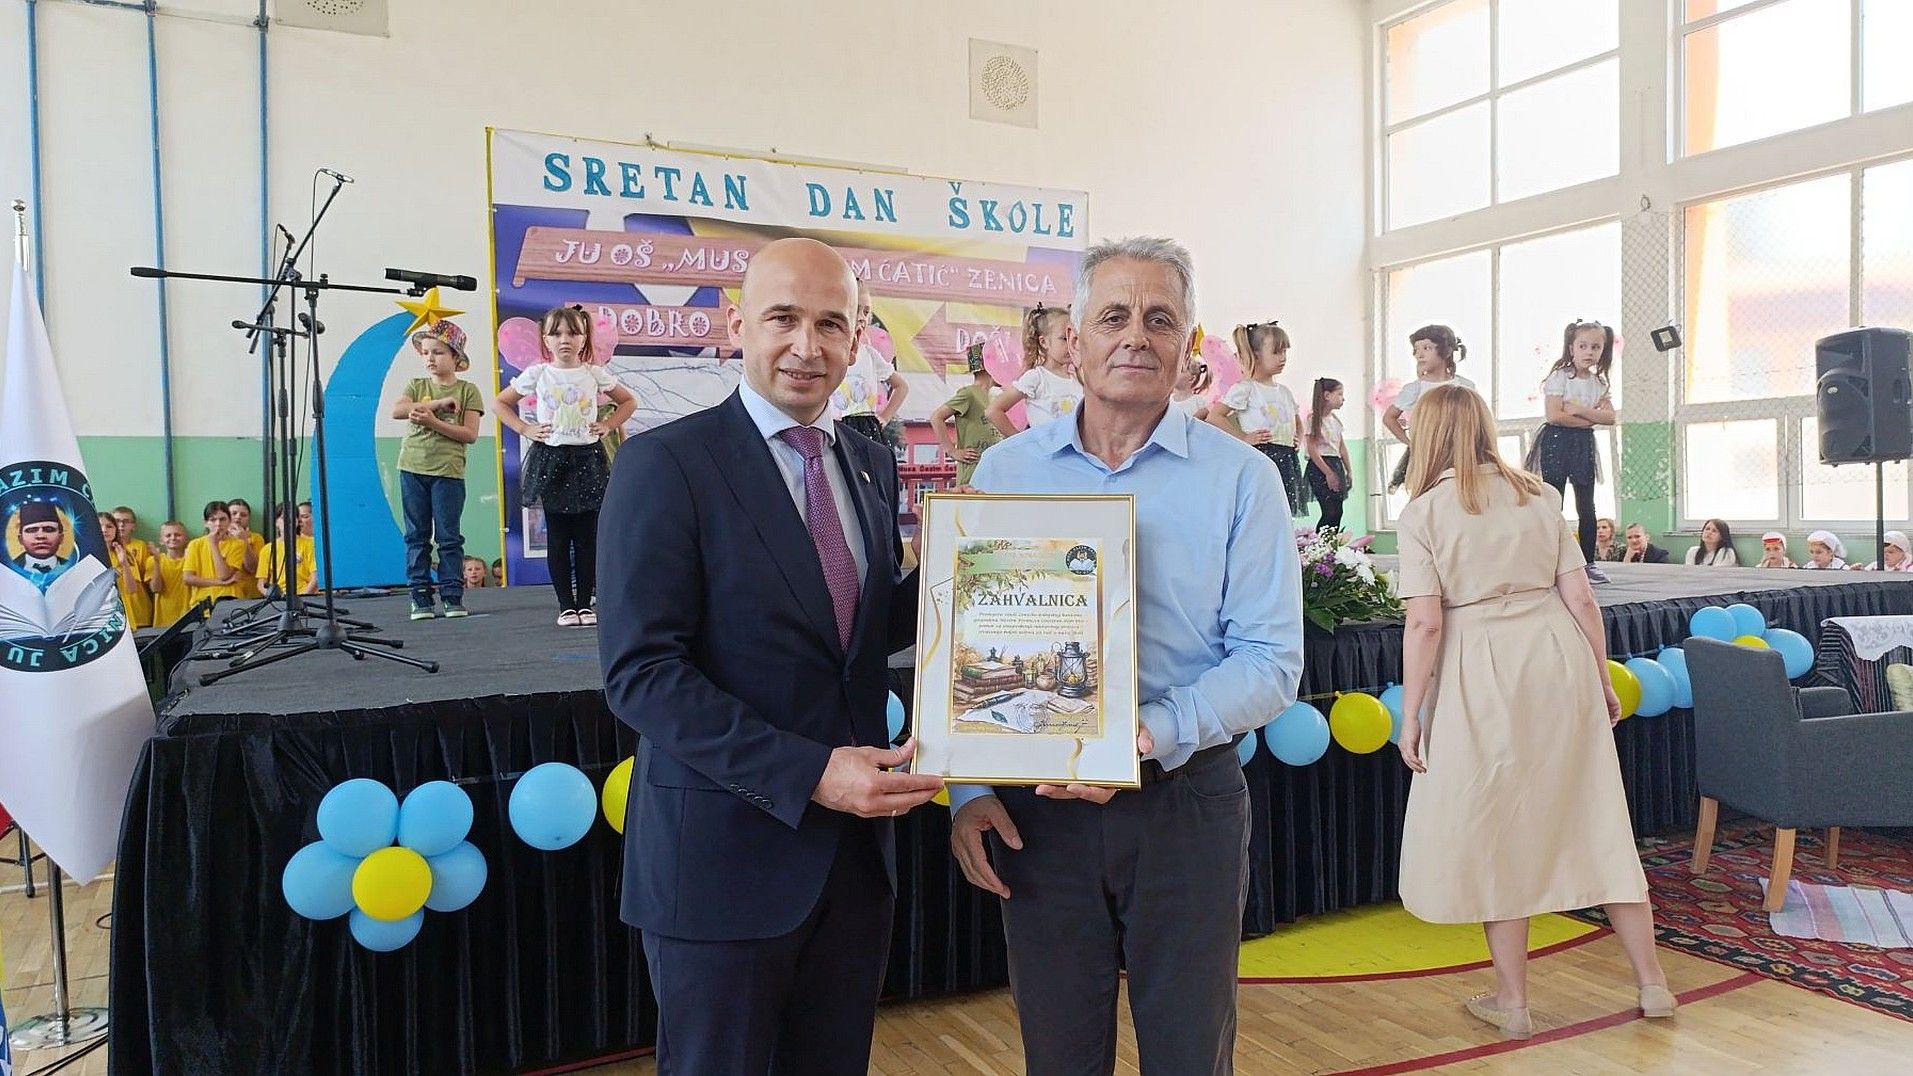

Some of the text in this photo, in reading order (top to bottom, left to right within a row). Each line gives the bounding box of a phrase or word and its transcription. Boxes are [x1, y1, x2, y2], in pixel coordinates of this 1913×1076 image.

[543, 152, 1075, 238] SRETAN DAN ŠKOLE
[555, 239, 602, 264] JU
[611, 239, 654, 268] OŠ
[968, 267, 1057, 294] ZENICA
[977, 591, 1088, 607] ZAHVALNICA
